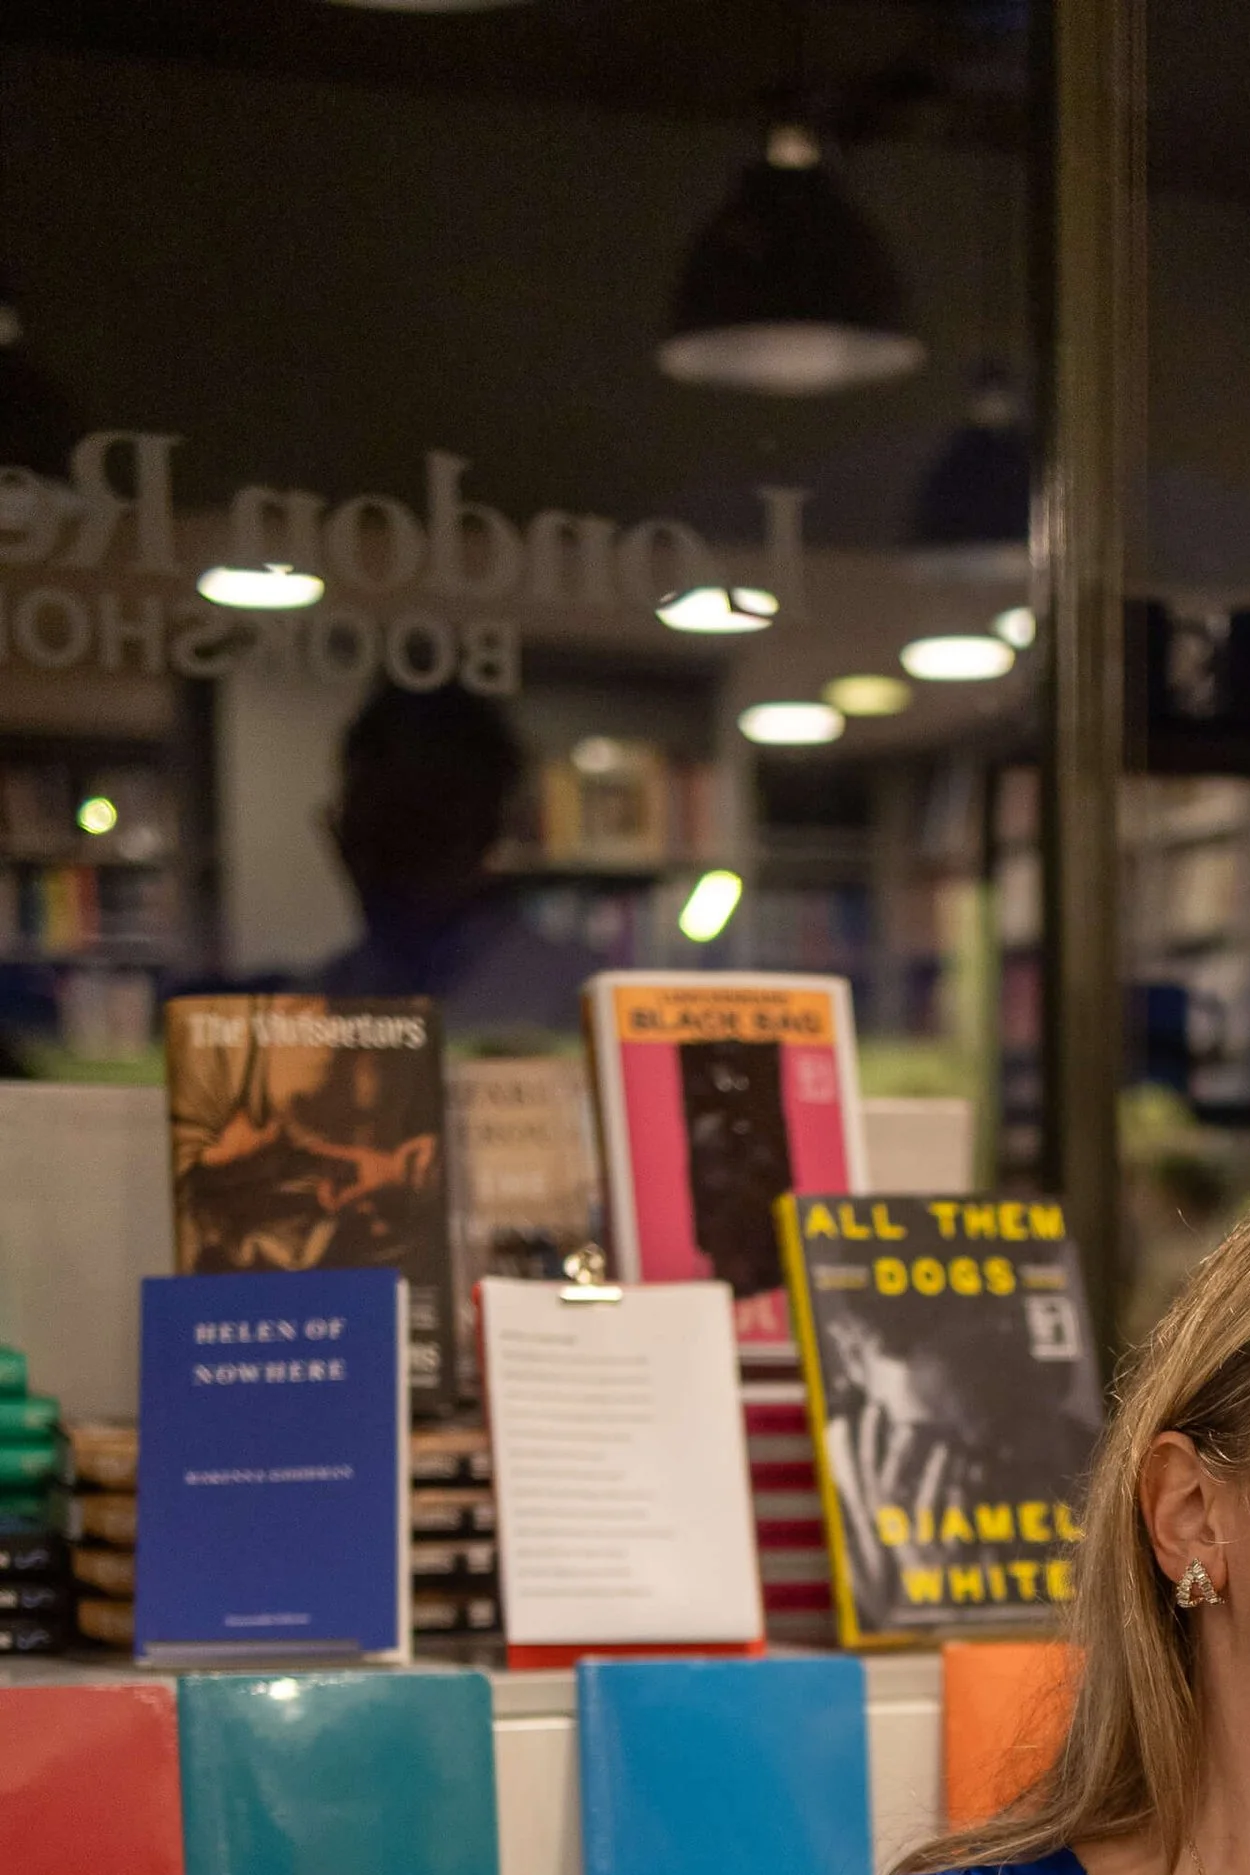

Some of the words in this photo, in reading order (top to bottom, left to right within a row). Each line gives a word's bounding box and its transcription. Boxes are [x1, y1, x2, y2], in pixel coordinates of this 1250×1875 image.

[189, 1012, 246, 1047] The
[629, 1006, 741, 1035] BLACK
[804, 1202, 908, 1241] ALL
[928, 1201, 1066, 1241] THEM
[873, 1255, 1017, 1297] DOGS
[194, 1320, 297, 1345] HELEN
[304, 1316, 348, 1341] OF
[193, 1357, 346, 1386] NOWHERE
[902, 1560, 1080, 1604] WHITE
